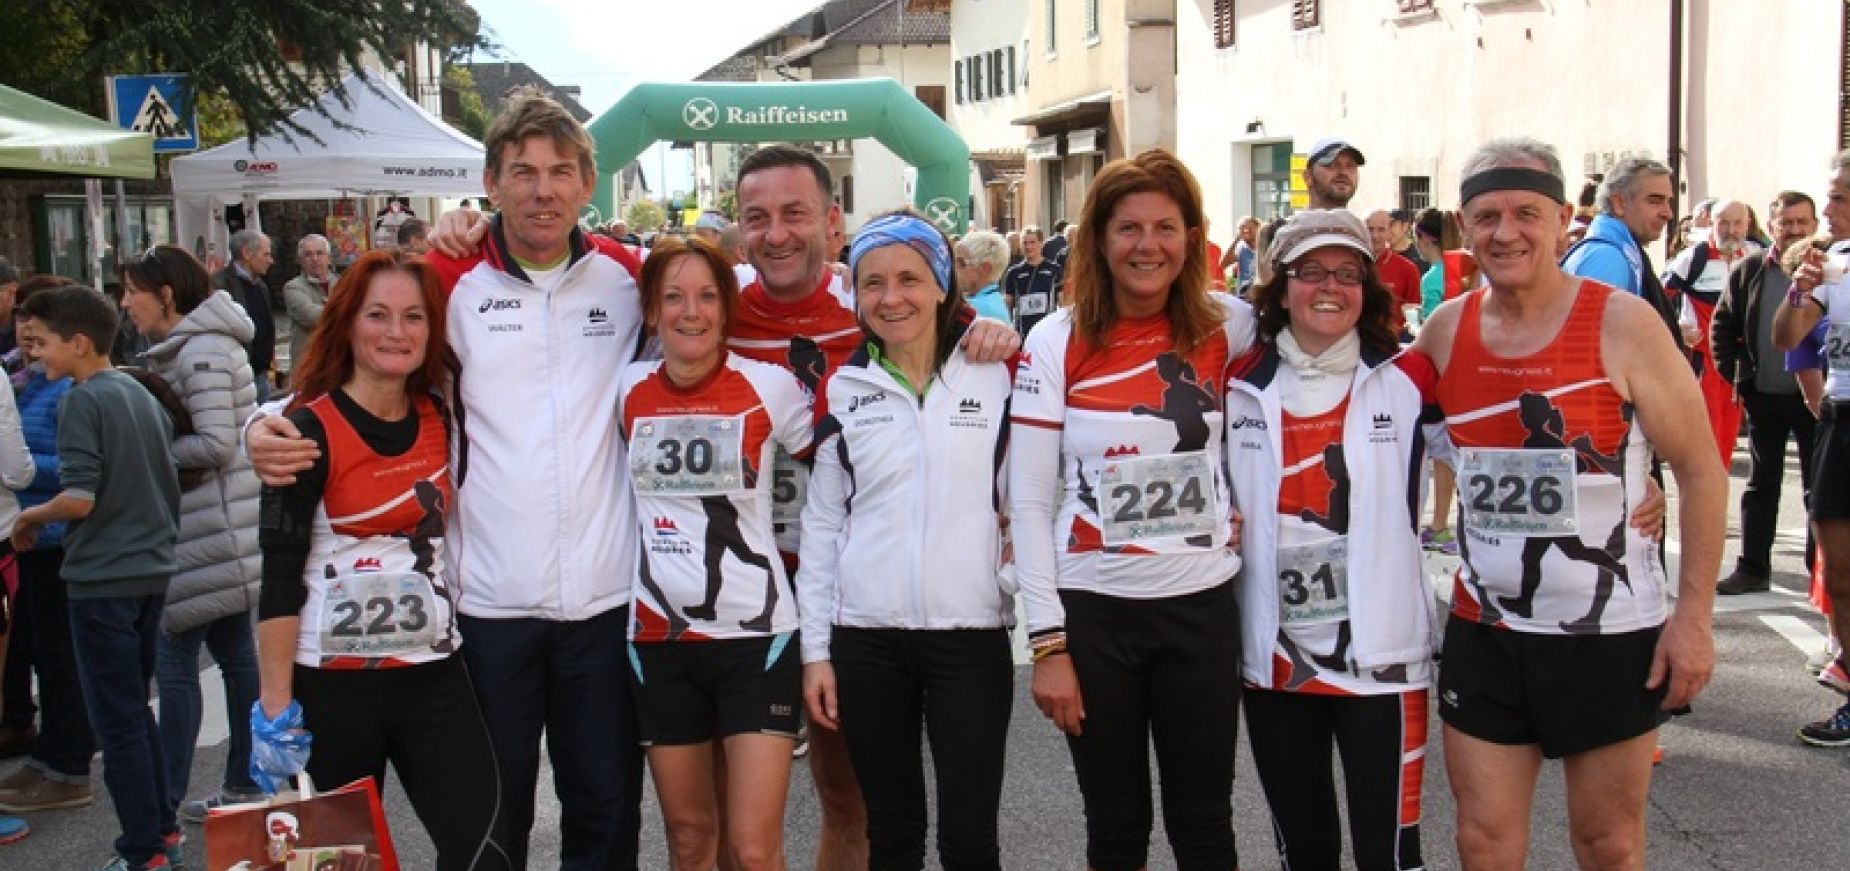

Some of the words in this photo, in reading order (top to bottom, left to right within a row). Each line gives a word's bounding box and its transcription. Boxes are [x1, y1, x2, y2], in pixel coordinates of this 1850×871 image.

[726, 105, 848, 124] Raiffeisen
[383, 166, 467, 178] www.admo.it
[656, 438, 713, 475] 30
[1111, 476, 1206, 523] 224
[1470, 474, 1563, 515] 226
[1280, 562, 1337, 604] 31
[331, 594, 428, 636] 223
